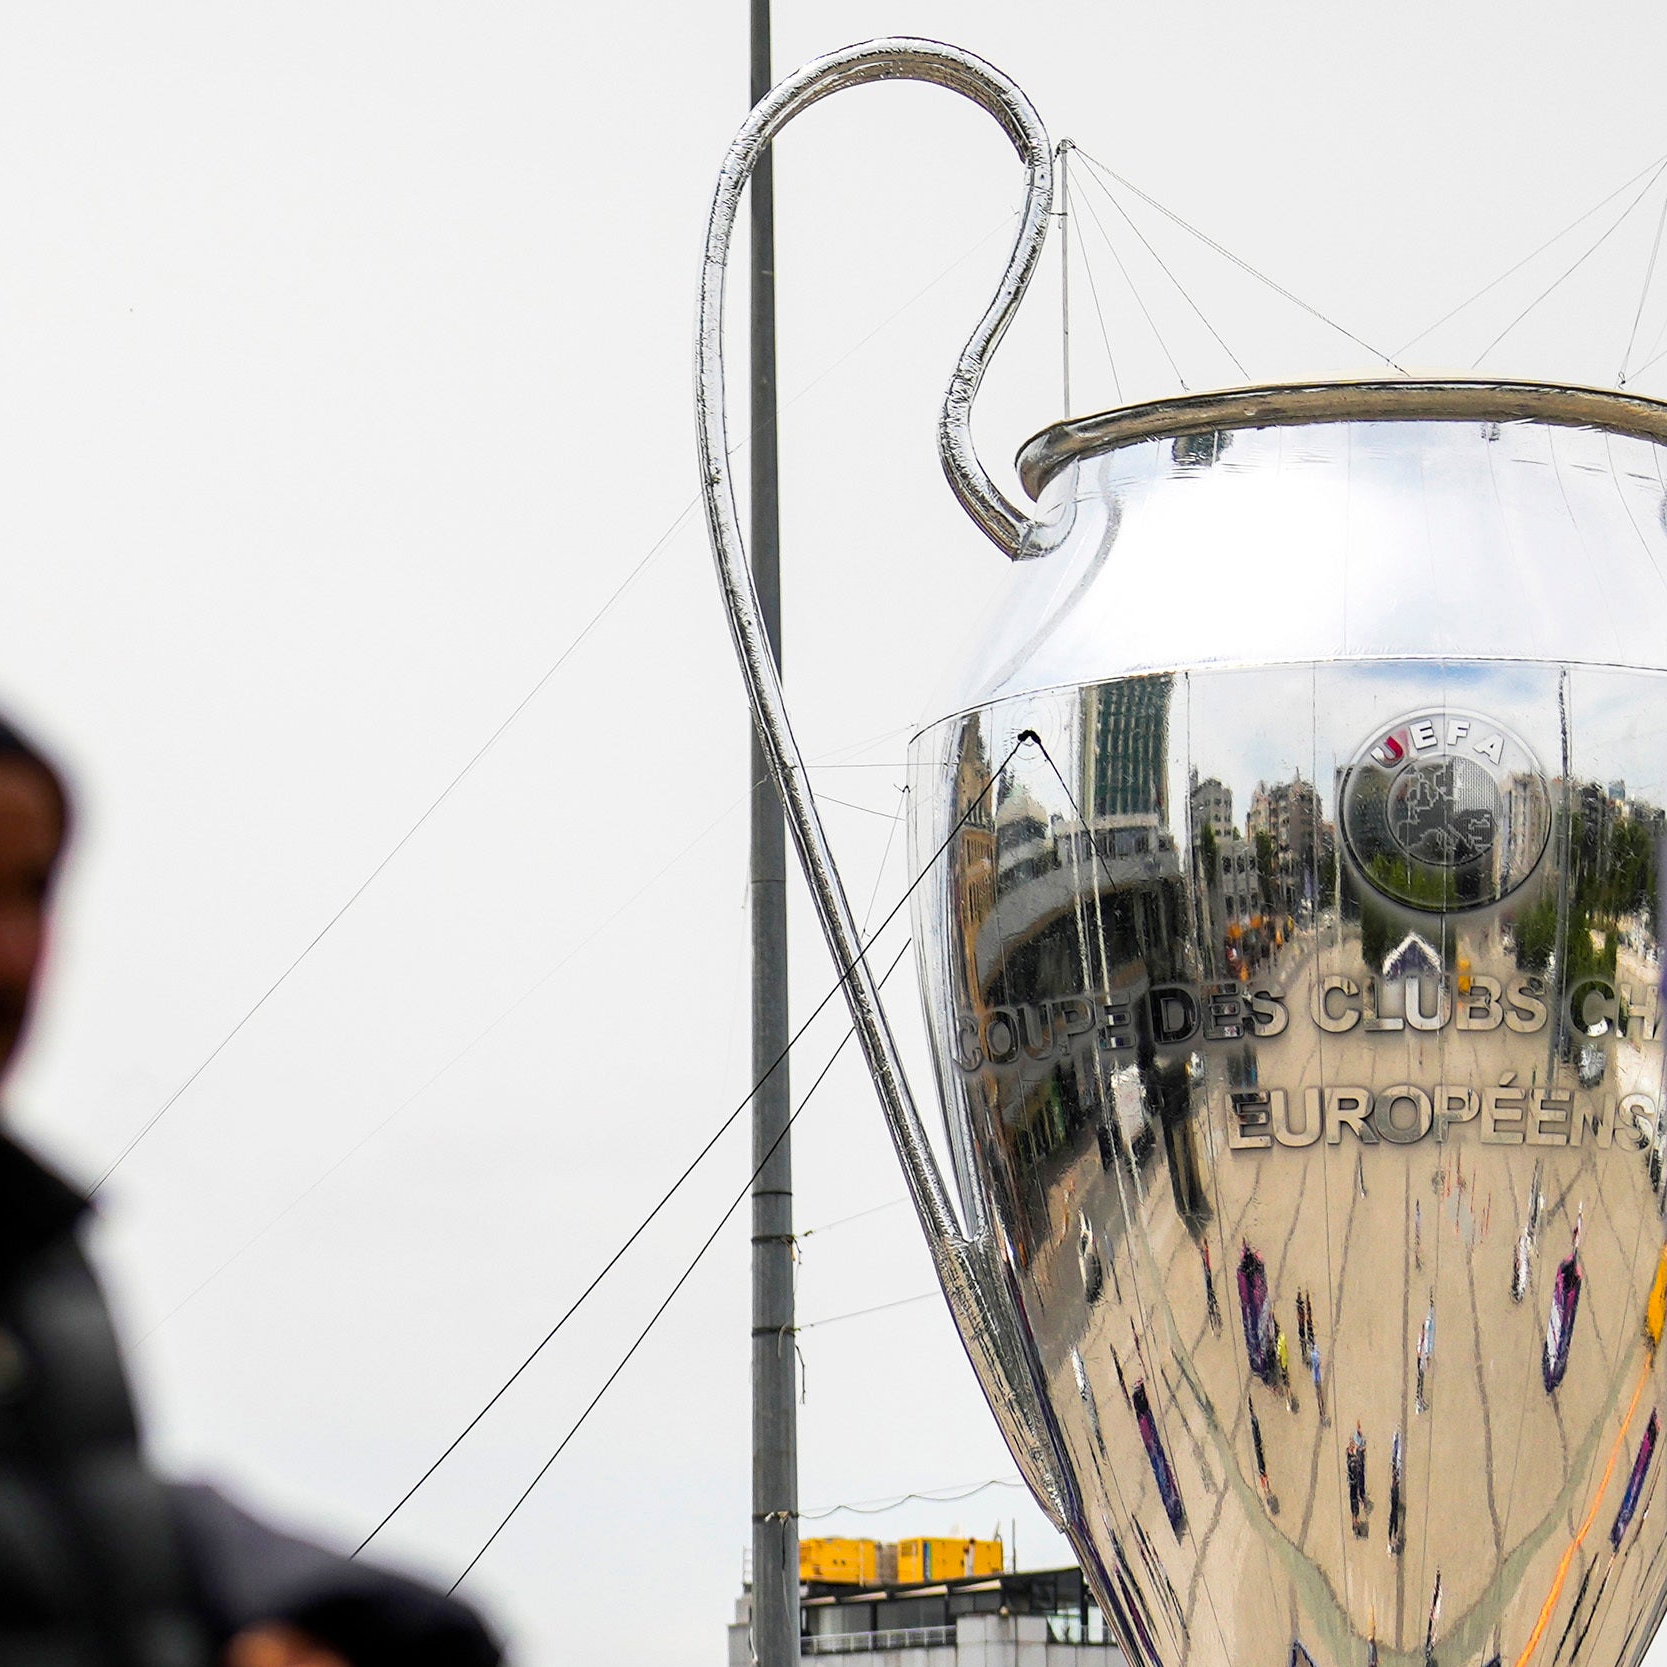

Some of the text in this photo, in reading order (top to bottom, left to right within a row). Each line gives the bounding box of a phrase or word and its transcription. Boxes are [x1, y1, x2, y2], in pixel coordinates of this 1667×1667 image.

[1371, 718, 1505, 768] UEFA
[954, 975, 1665, 1071] COUPE DES CLUBS CH
[1225, 1071, 1656, 1152] EUROPÉENS
